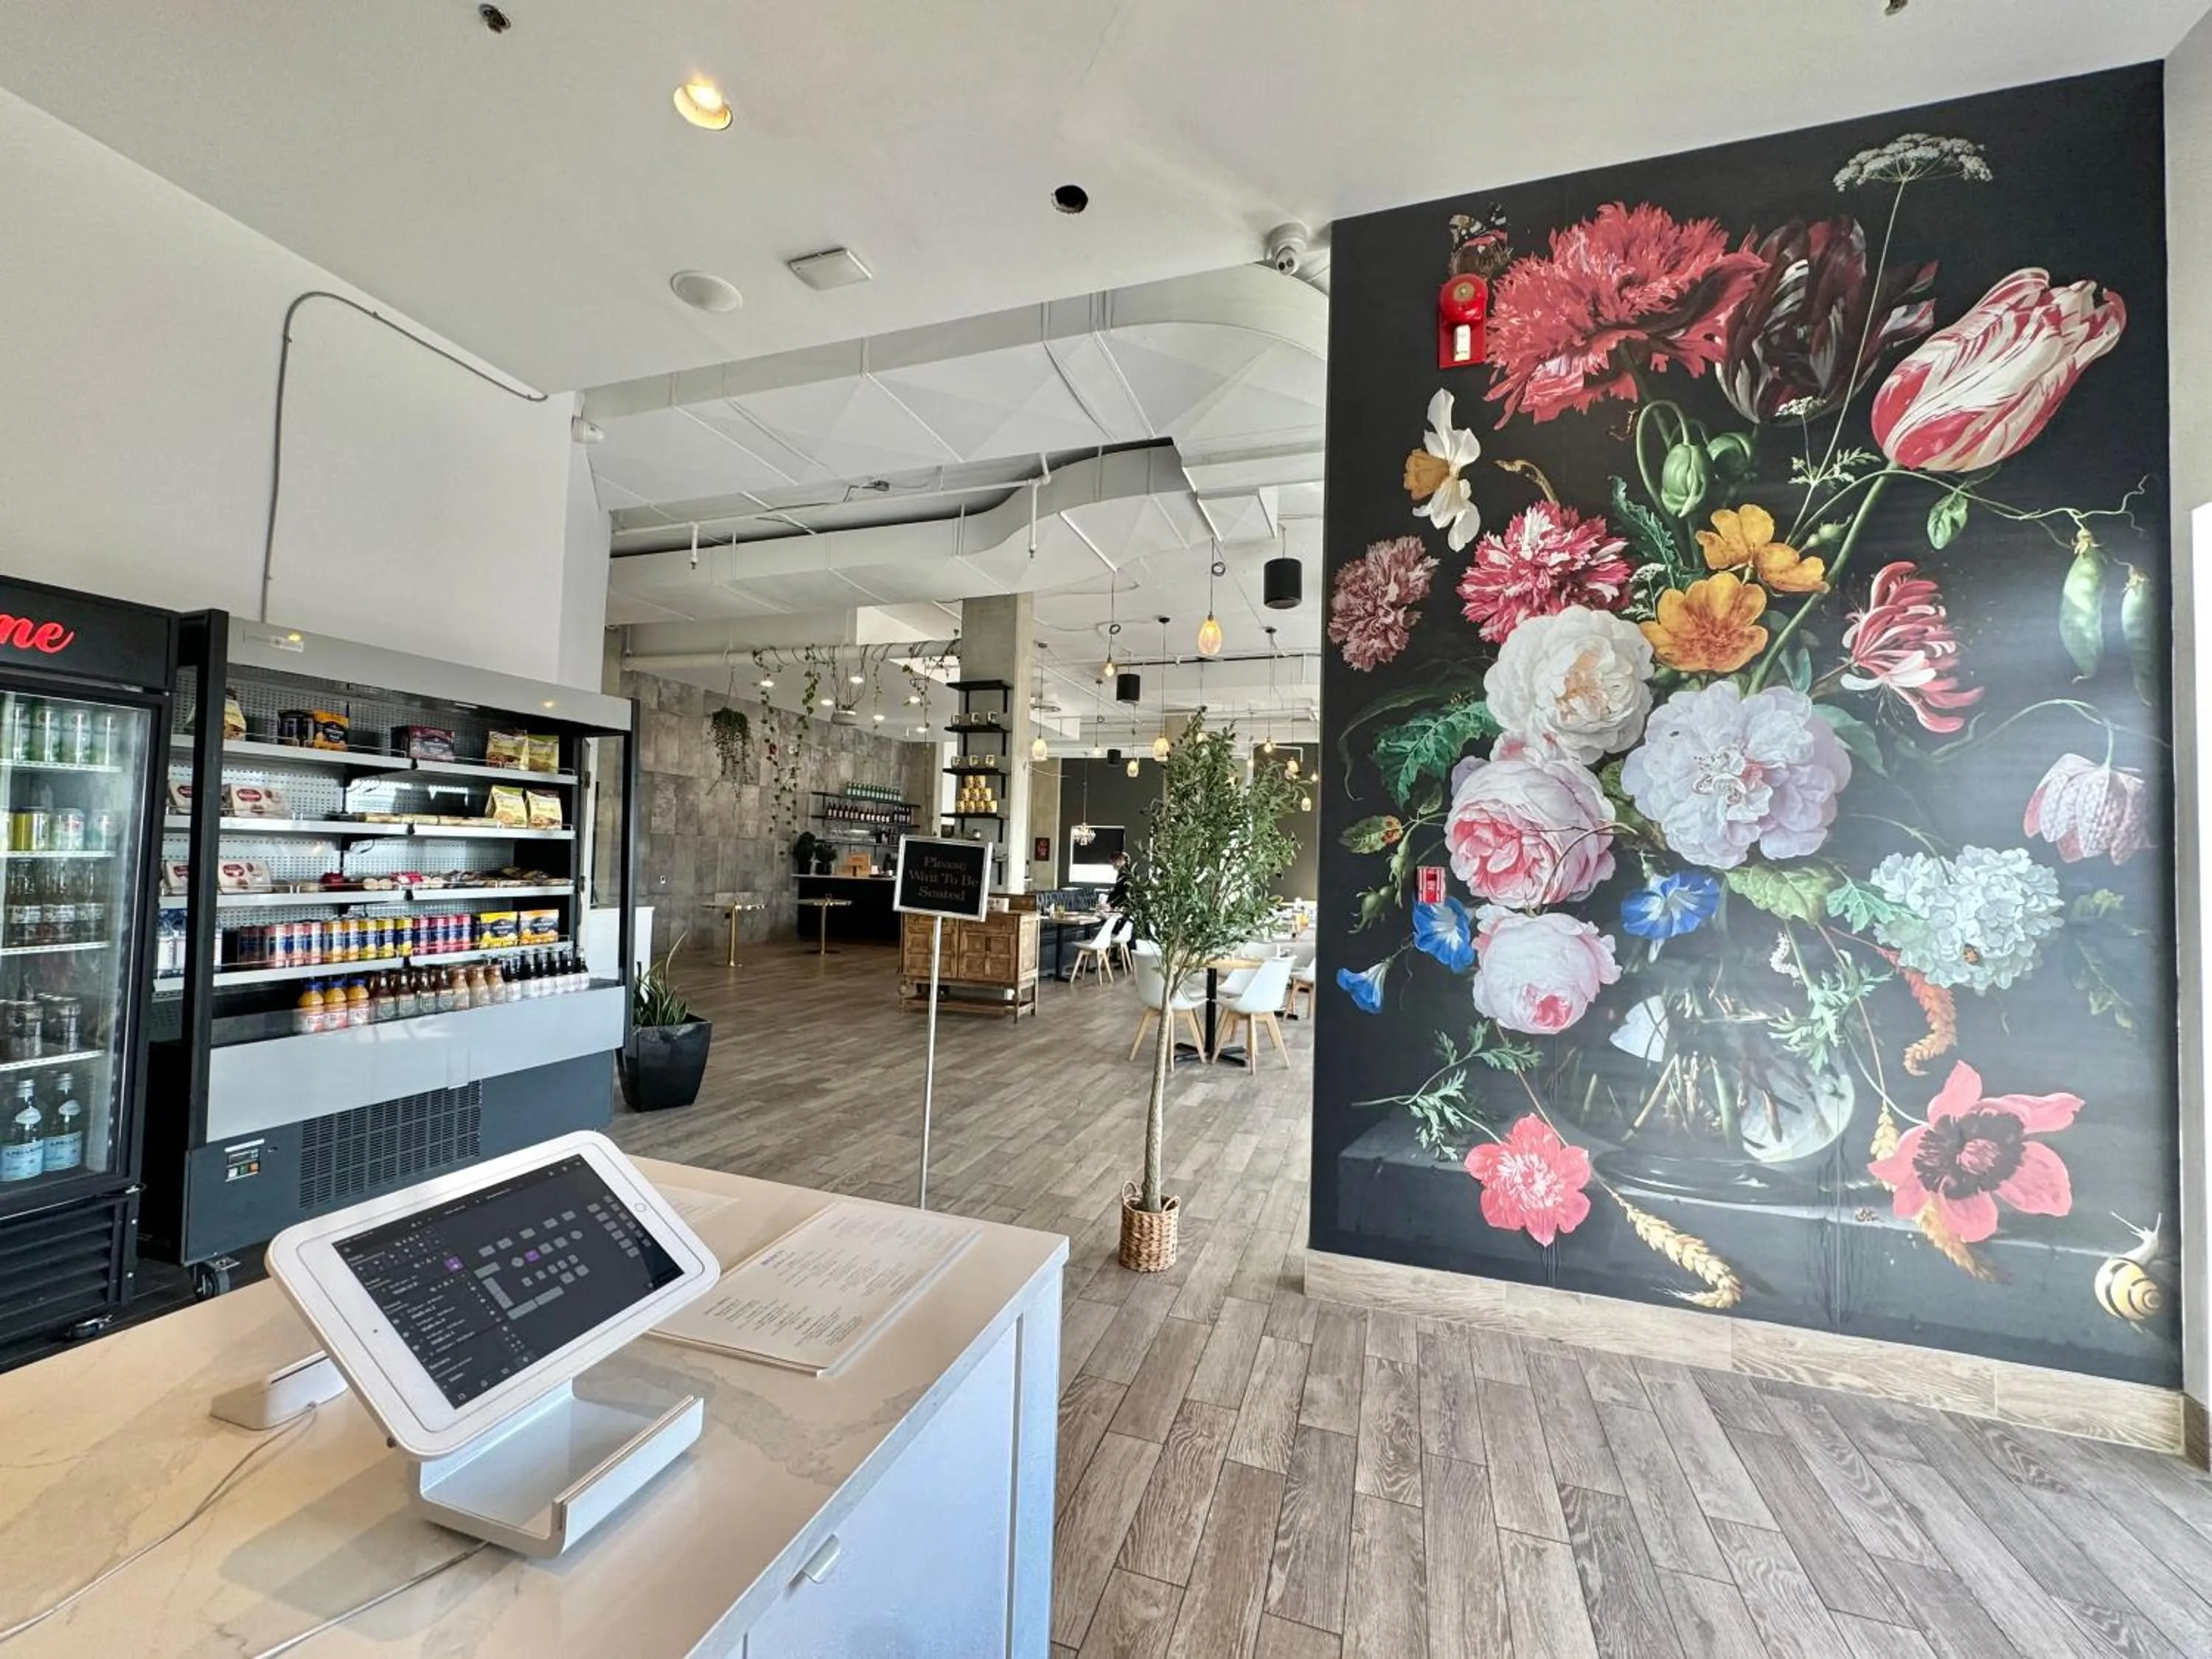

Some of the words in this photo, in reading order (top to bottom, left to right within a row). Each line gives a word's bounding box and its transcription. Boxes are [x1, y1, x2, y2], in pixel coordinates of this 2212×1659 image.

[924, 856, 967, 870] Please
[909, 869, 938, 883] Wait
[942, 873, 958, 885] To
[961, 875, 979, 887] Be
[918, 886, 966, 901] Seated
